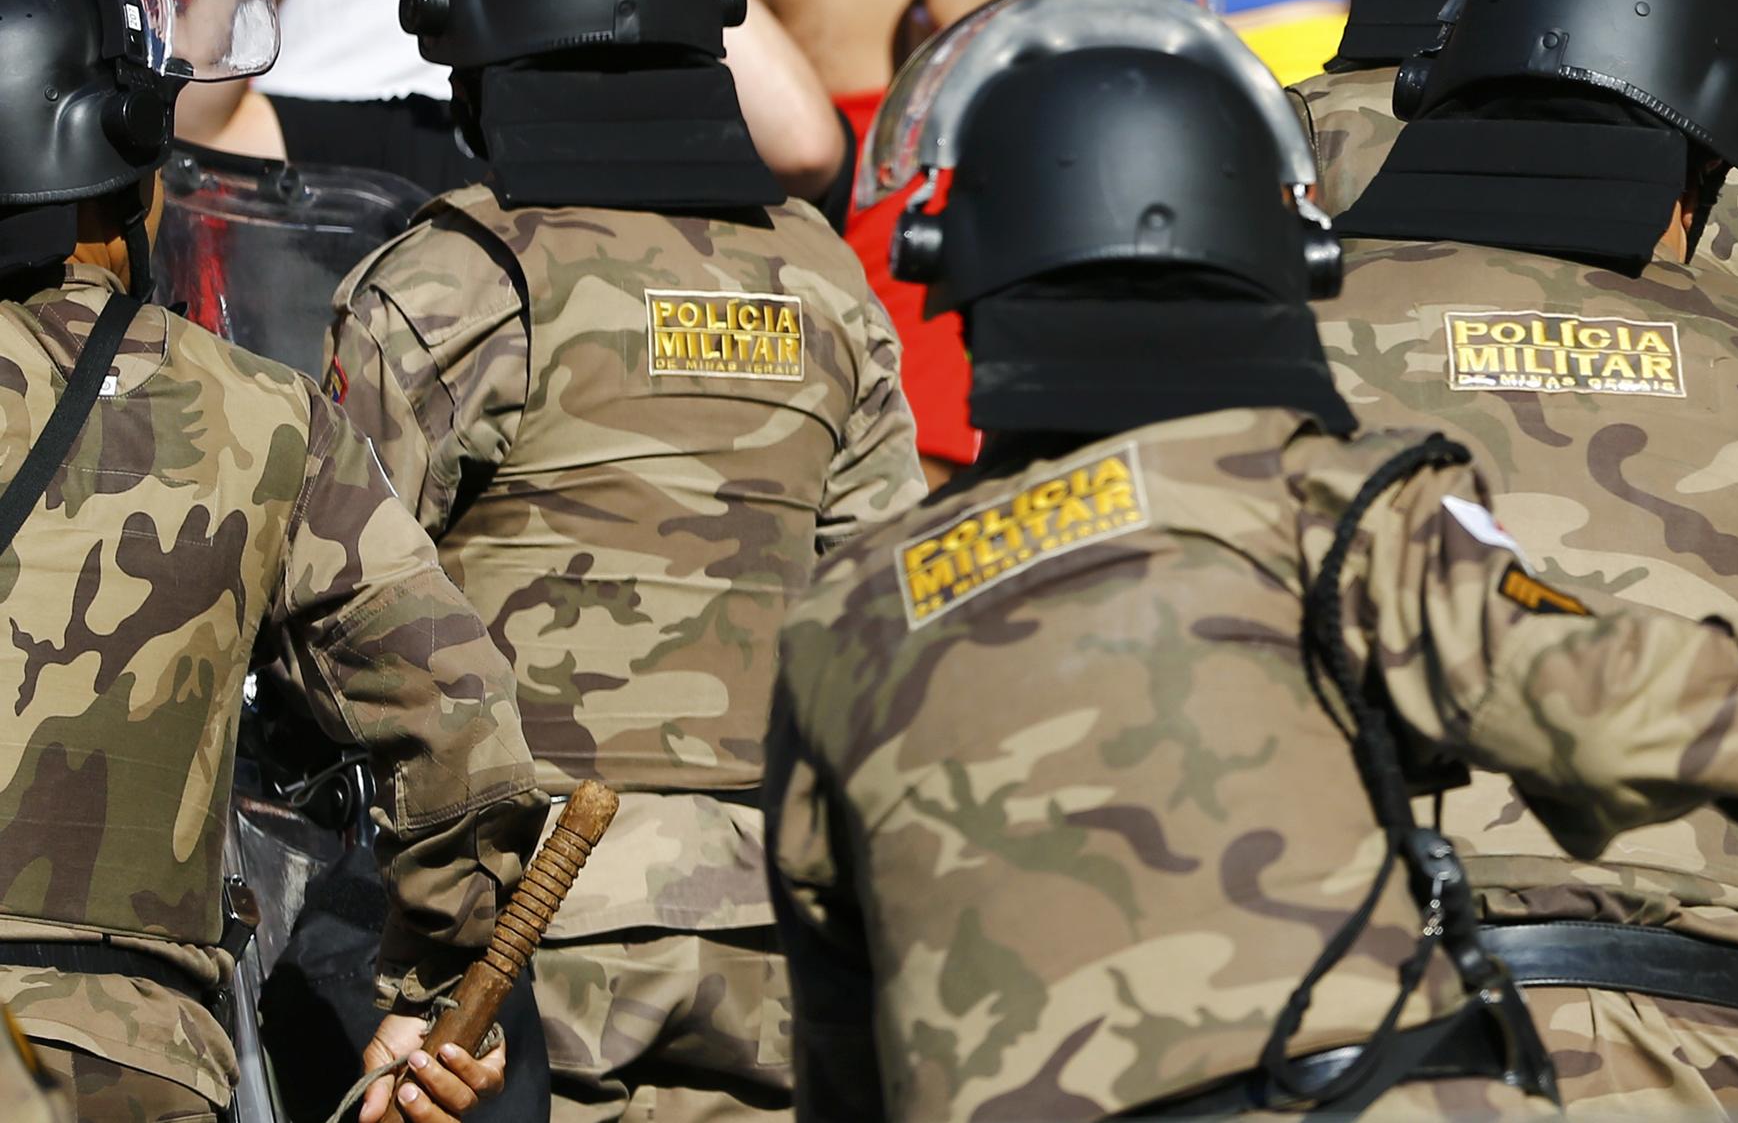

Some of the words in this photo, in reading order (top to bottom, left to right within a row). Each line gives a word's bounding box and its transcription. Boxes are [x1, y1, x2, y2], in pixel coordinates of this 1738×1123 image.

[652, 299, 799, 333] POLÍCIA
[655, 332, 799, 364] MILITAR
[1454, 320, 1671, 353] POLÍCIA
[655, 358, 677, 369] DE
[1457, 347, 1674, 380] MILITAR
[908, 481, 1135, 602] MILITAR
